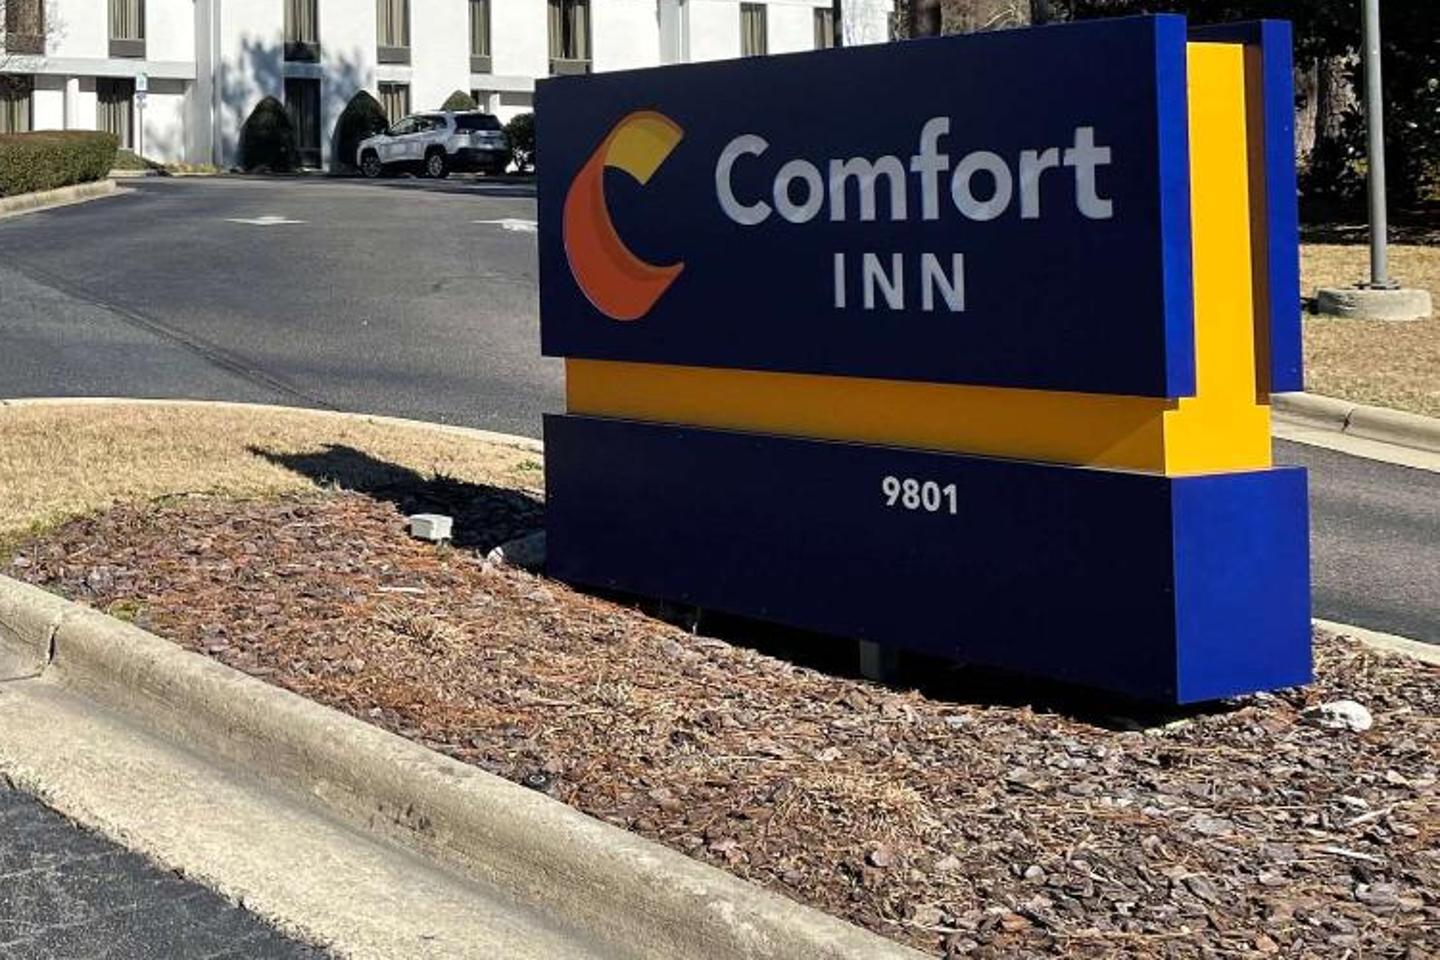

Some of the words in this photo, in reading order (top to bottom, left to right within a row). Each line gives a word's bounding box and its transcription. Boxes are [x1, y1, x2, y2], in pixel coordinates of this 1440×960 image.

[715, 116, 1113, 226] Comfort
[833, 252, 965, 312] INN
[882, 476, 957, 514] 9801
